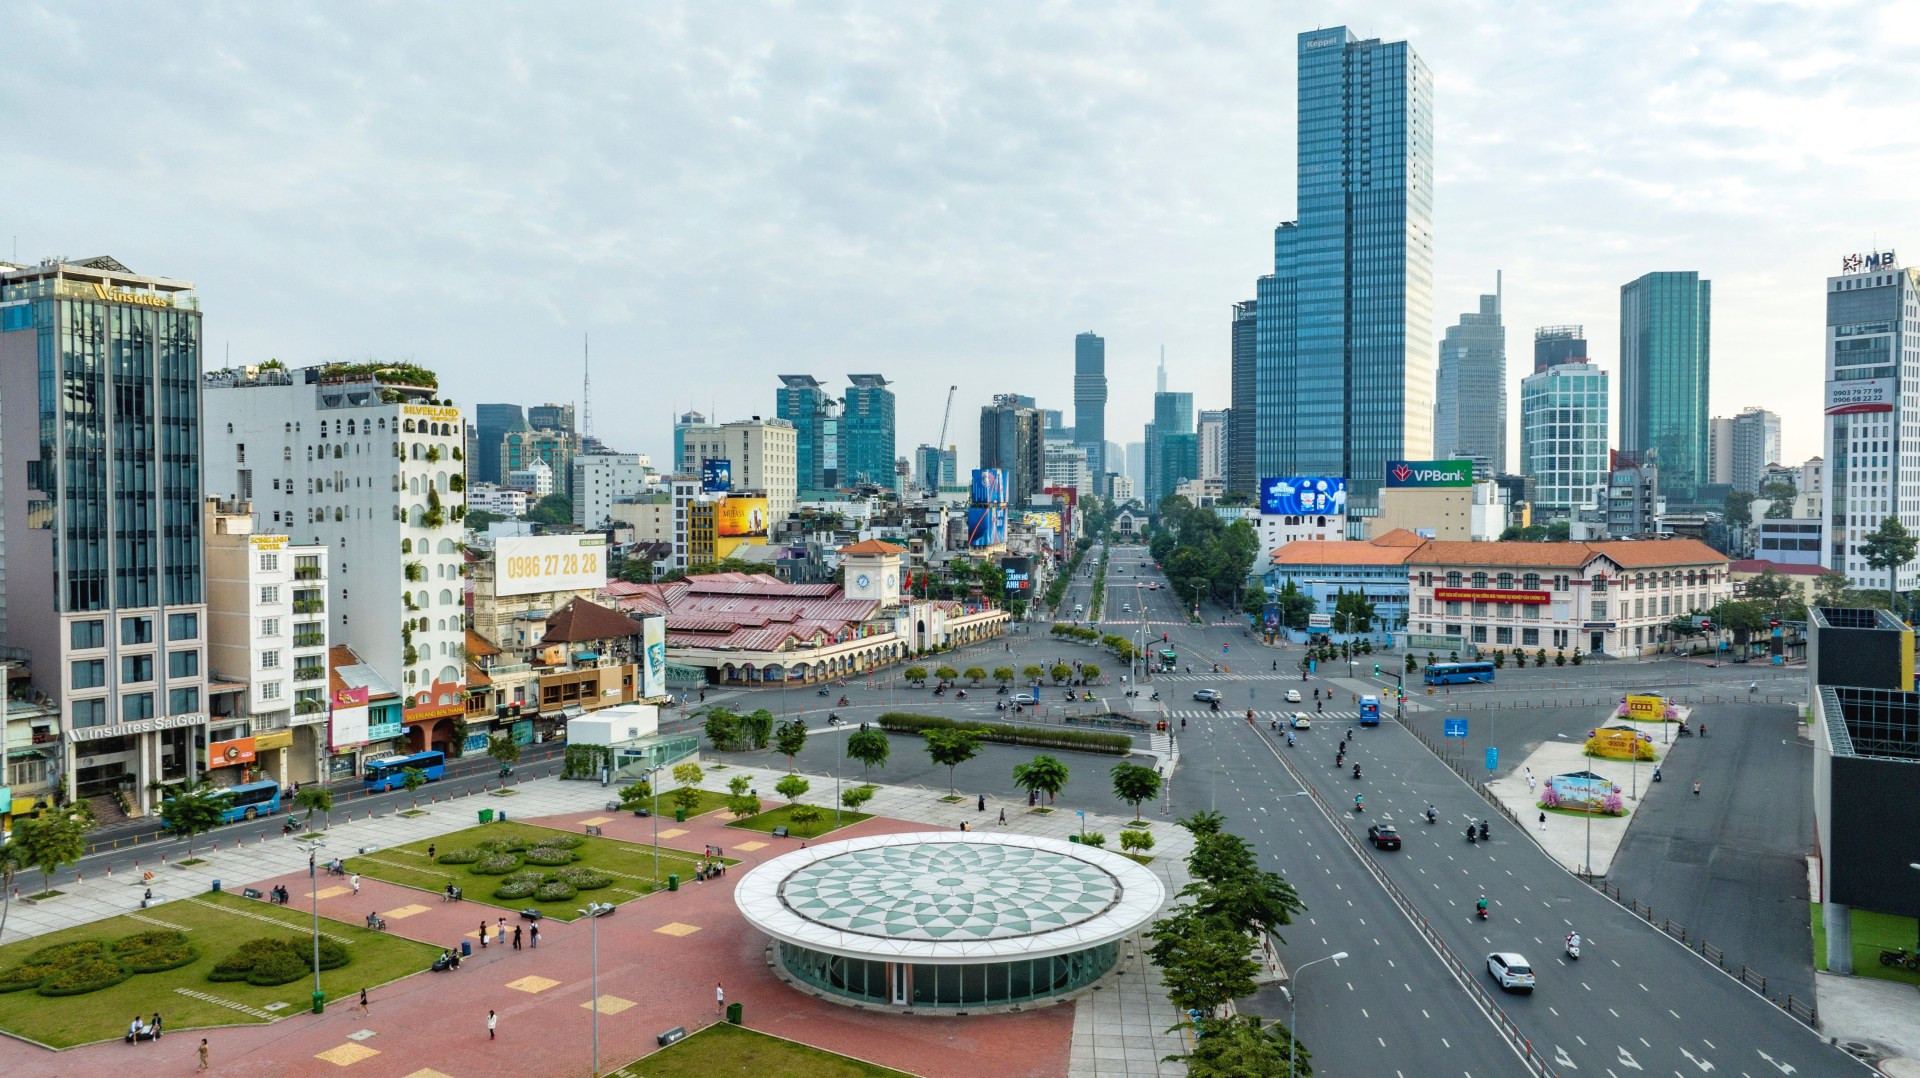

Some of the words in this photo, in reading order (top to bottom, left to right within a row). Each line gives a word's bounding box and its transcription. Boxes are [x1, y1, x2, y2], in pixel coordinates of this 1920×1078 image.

[1307, 37, 1336, 48] Keppel
[1865, 252, 1894, 267] MB
[92, 283, 167, 307] Winsuites
[403, 405, 459, 417] SILVERLAND
[1414, 469, 1465, 481] VPBank
[723, 510, 745, 518] MUFASA
[507, 555, 540, 579] 0986
[544, 554, 559, 576] 27
[563, 553, 578, 575] 28
[582, 553, 597, 574] 28
[1006, 580, 1019, 588] ANH
[1020, 580, 1029, 588] EM
[406, 711, 437, 720] SILVERLAND
[447, 707, 465, 715] THANH
[67, 722, 150, 743] Winsuites
[154, 714, 205, 730] SaiGon
